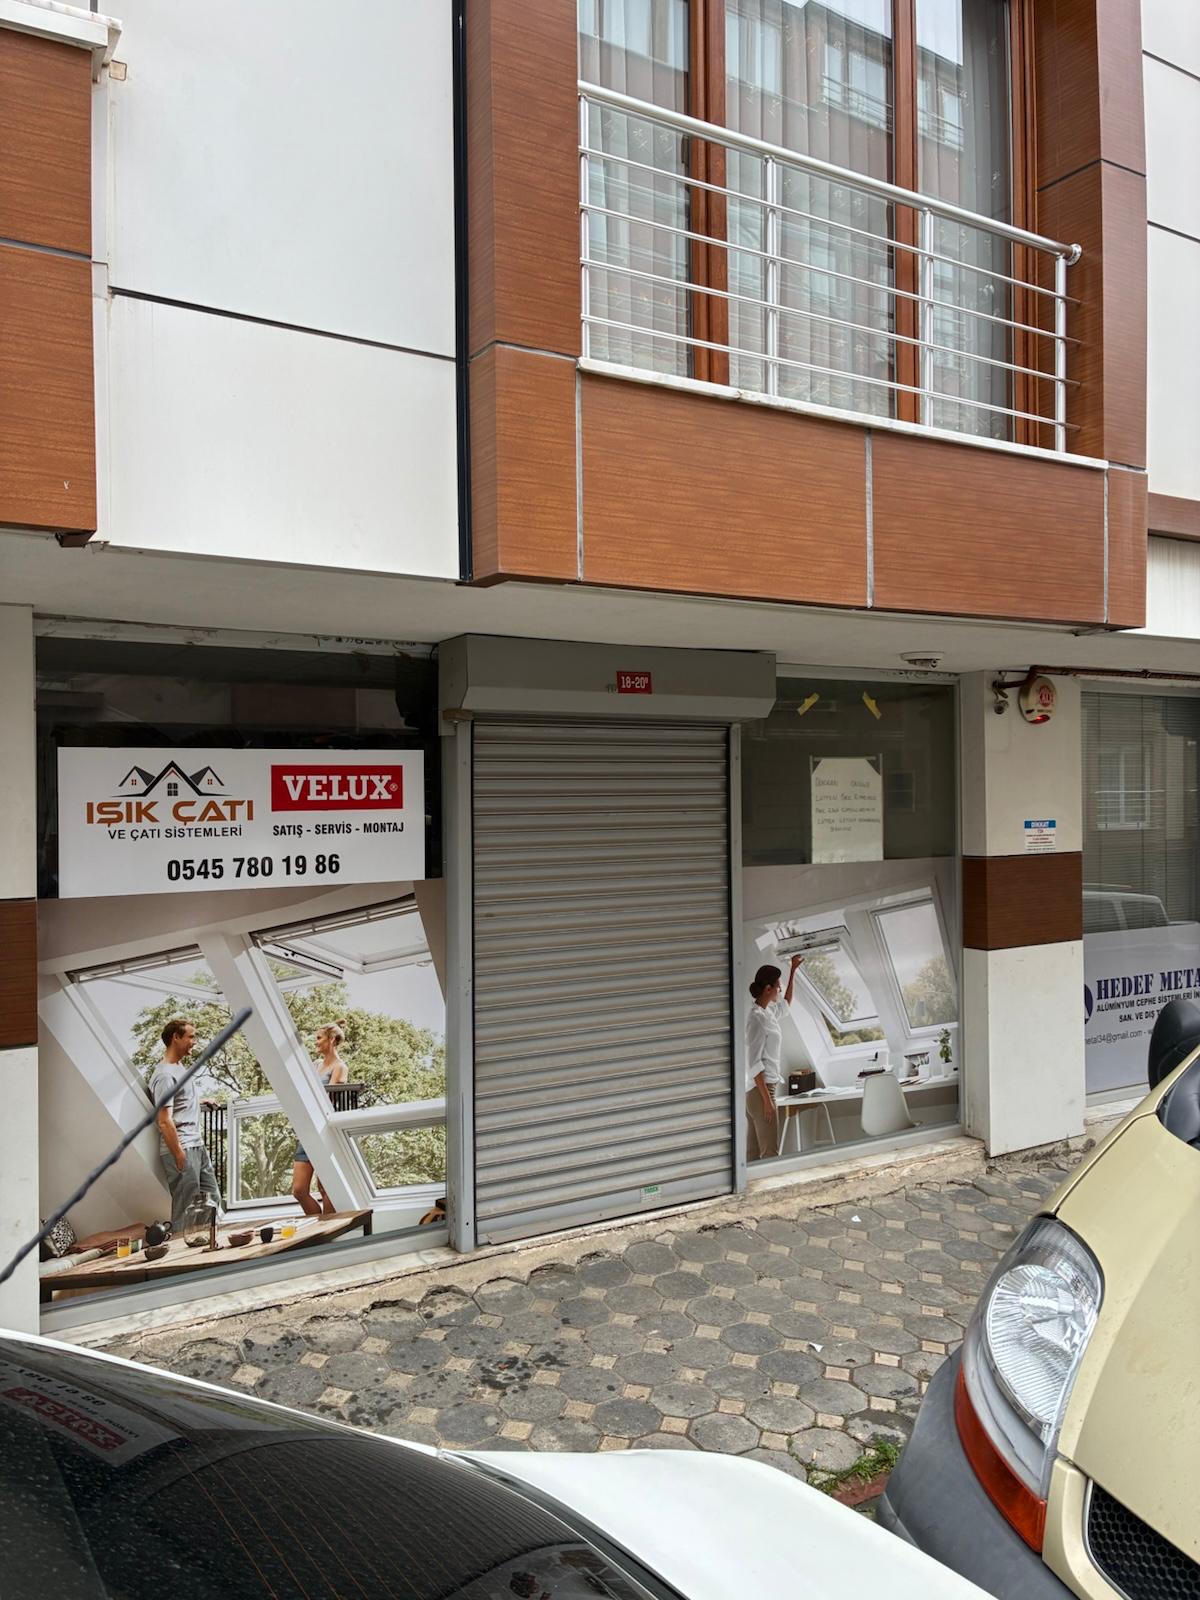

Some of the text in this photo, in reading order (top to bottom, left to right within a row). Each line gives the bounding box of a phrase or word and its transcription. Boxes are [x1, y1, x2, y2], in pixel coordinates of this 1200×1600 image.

[86, 800, 254, 827] IŞIK ÇATI
[108, 825, 243, 841] VE ÇATI SİSTEMLERİ
[272, 824, 303, 838] SATIŞ
[314, 820, 352, 835] SERVİS
[363, 821, 404, 833] MONTAJ
[167, 853, 341, 881] 0545 780 19 86
[1096, 974, 1154, 1000] HEDEF
[1096, 1000, 1135, 1012] ALÜMİNYUM
[1136, 997, 1157, 1007] CEPHE
[1119, 1014, 1134, 1022] SAN.
[1135, 1011, 1144, 1020] VE
[1144, 1010, 1155, 1019] DIŞ
[1084, 1030, 1143, 1044] etal34@gmail.com
